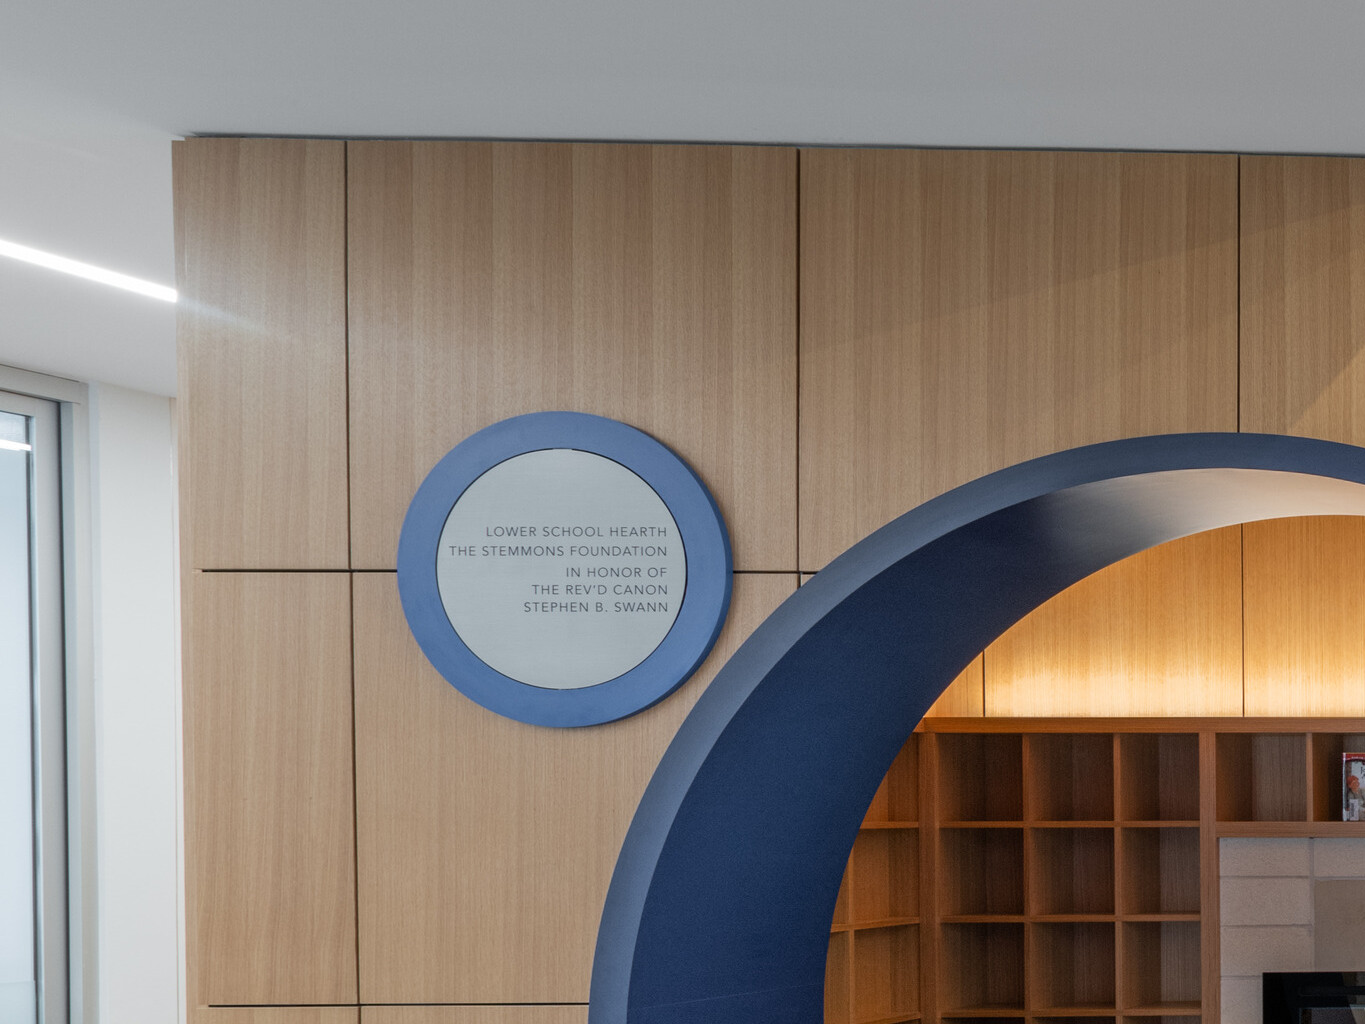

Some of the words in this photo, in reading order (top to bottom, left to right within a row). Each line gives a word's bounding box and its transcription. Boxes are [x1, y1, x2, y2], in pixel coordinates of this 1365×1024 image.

[485, 526, 536, 538] LOWER
[542, 526, 604, 538] SCHOOL
[609, 526, 667, 538] HEARTH
[448, 545, 477, 557] THE
[481, 545, 565, 557] STEMMONS
[569, 545, 668, 557] FOUNDATION
[565, 567, 581, 578] IN
[586, 567, 642, 578] HONOR
[647, 567, 668, 578] OF
[531, 584, 560, 596] THE
[565, 584, 608, 596] REV'D
[612, 584, 668, 596] CANON
[523, 601, 589, 613] STEPHEN
[595, 601, 608, 613] B.
[613, 601, 668, 613] SWANN
